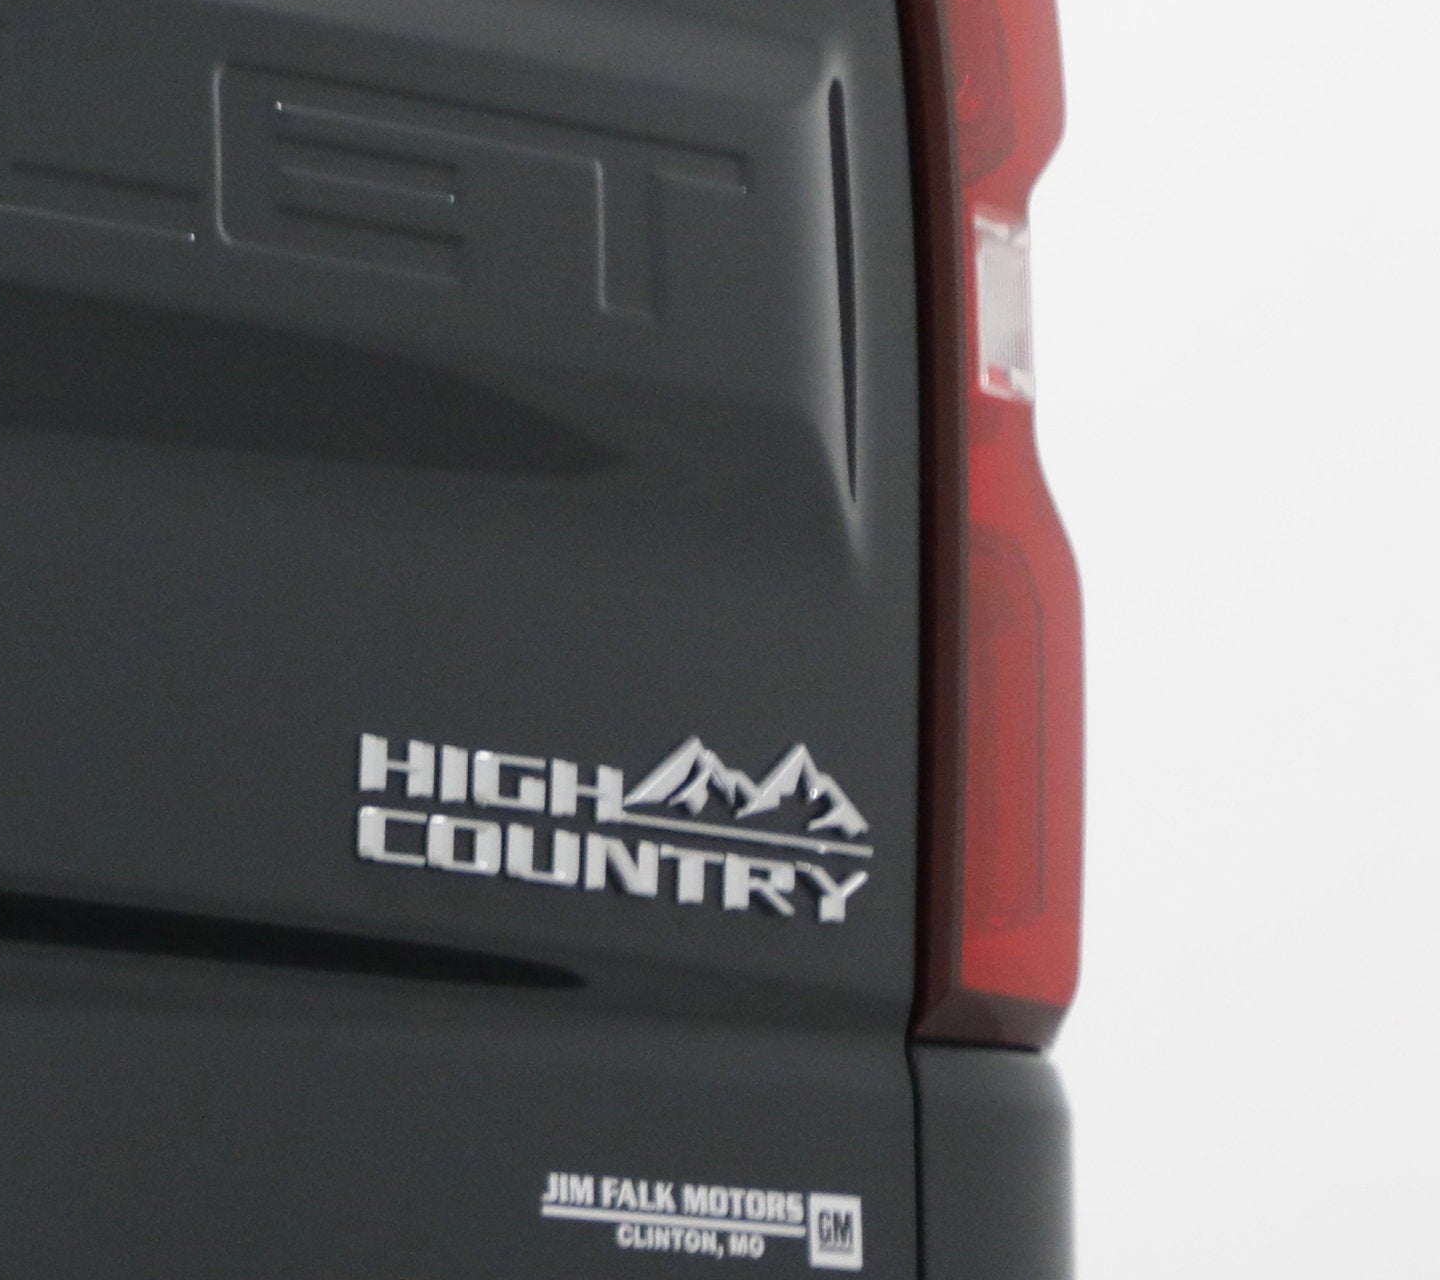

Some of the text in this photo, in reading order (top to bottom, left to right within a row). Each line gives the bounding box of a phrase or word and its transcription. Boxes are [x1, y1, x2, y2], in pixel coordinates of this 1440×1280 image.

[359, 732, 625, 822] HIGH
[358, 806, 869, 922] COUNTRY
[542, 1172, 804, 1223] JIM FALK MOTORS
[616, 1222, 766, 1260] CLINTON, MO
